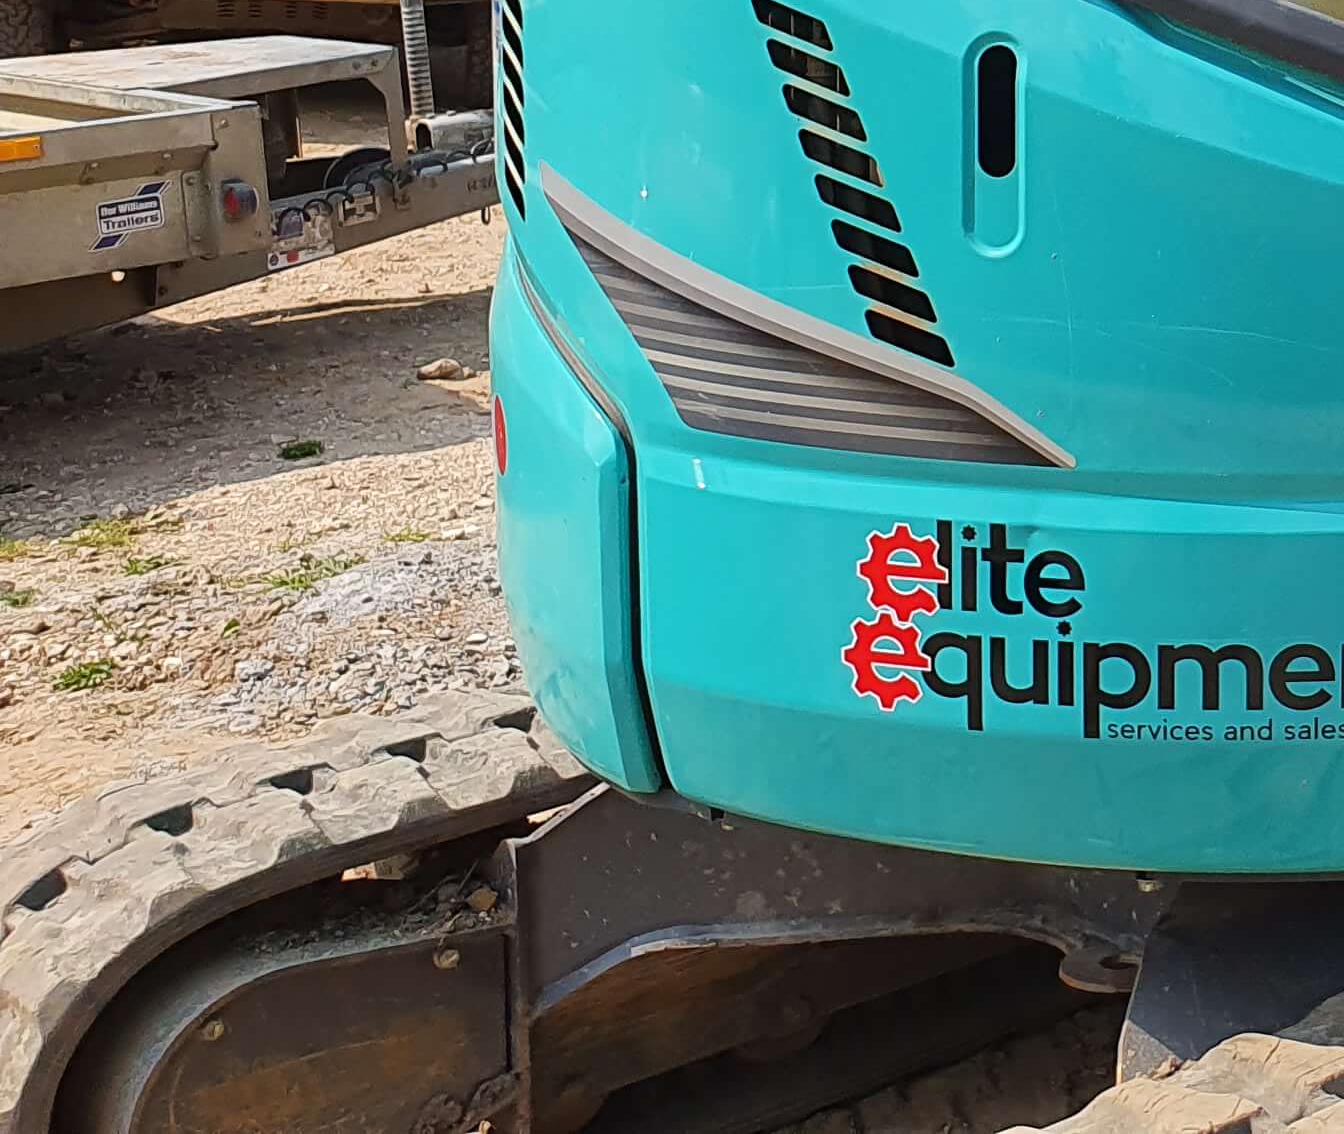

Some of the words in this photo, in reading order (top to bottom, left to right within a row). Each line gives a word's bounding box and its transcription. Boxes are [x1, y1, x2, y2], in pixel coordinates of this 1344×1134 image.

[103, 214, 159, 230] Trailers
[857, 519, 1086, 623] elite
[1106, 717, 1214, 742] services
[1223, 717, 1274, 742] and
